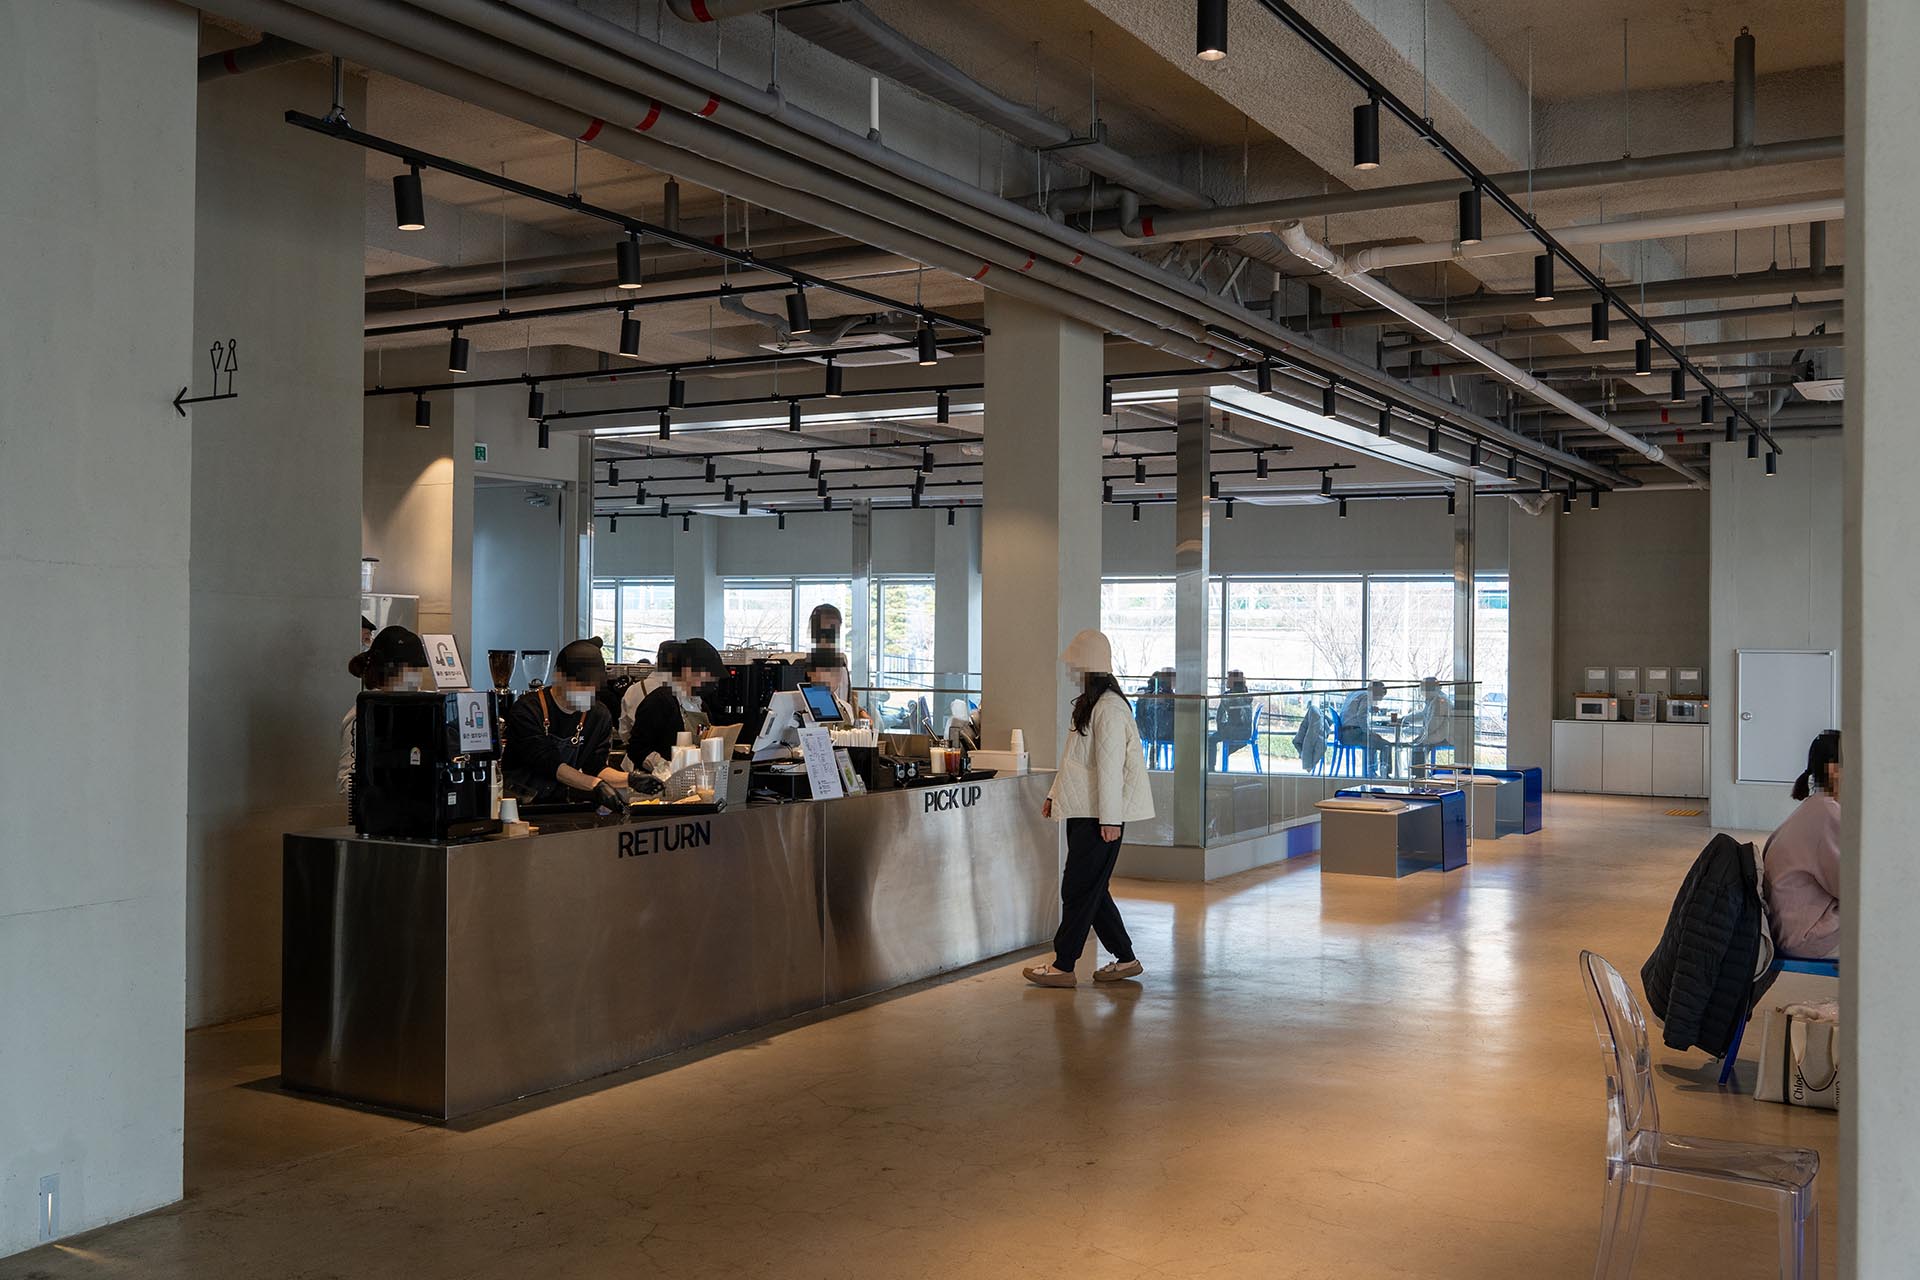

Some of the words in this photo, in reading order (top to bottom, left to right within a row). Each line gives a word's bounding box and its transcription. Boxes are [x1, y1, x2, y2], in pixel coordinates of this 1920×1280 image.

[925, 788, 959, 813] PICK
[962, 785, 982, 808] UP
[618, 820, 711, 859] RETURN
